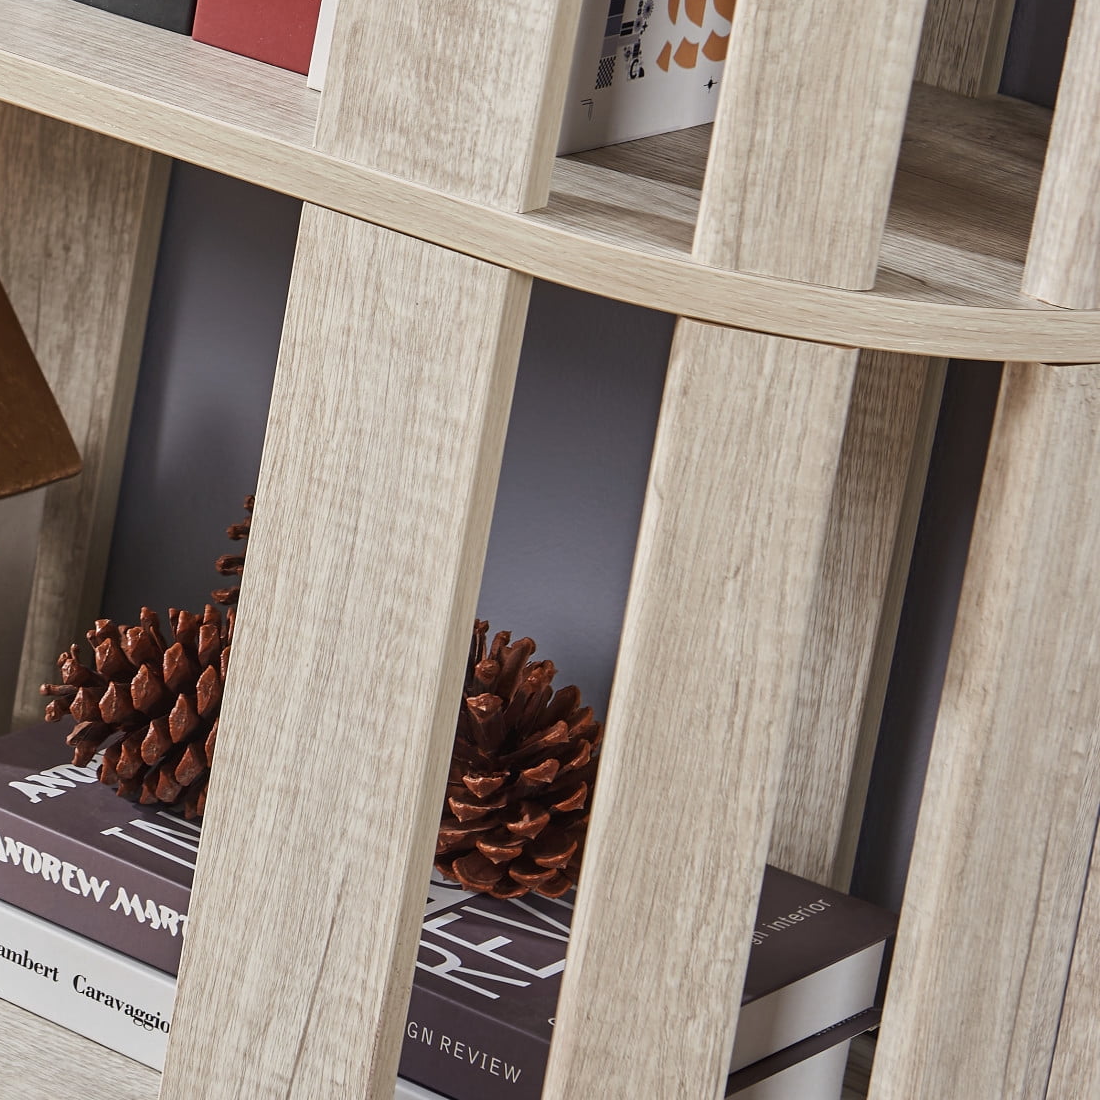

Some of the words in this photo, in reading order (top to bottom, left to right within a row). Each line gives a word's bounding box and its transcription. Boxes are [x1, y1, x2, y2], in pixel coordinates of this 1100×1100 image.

[761, 899, 832, 932] interior
[72, 974, 171, 1034] Caravaggio
[407, 1021, 434, 1047] GN
[440, 1035, 522, 1085] REVIEW
